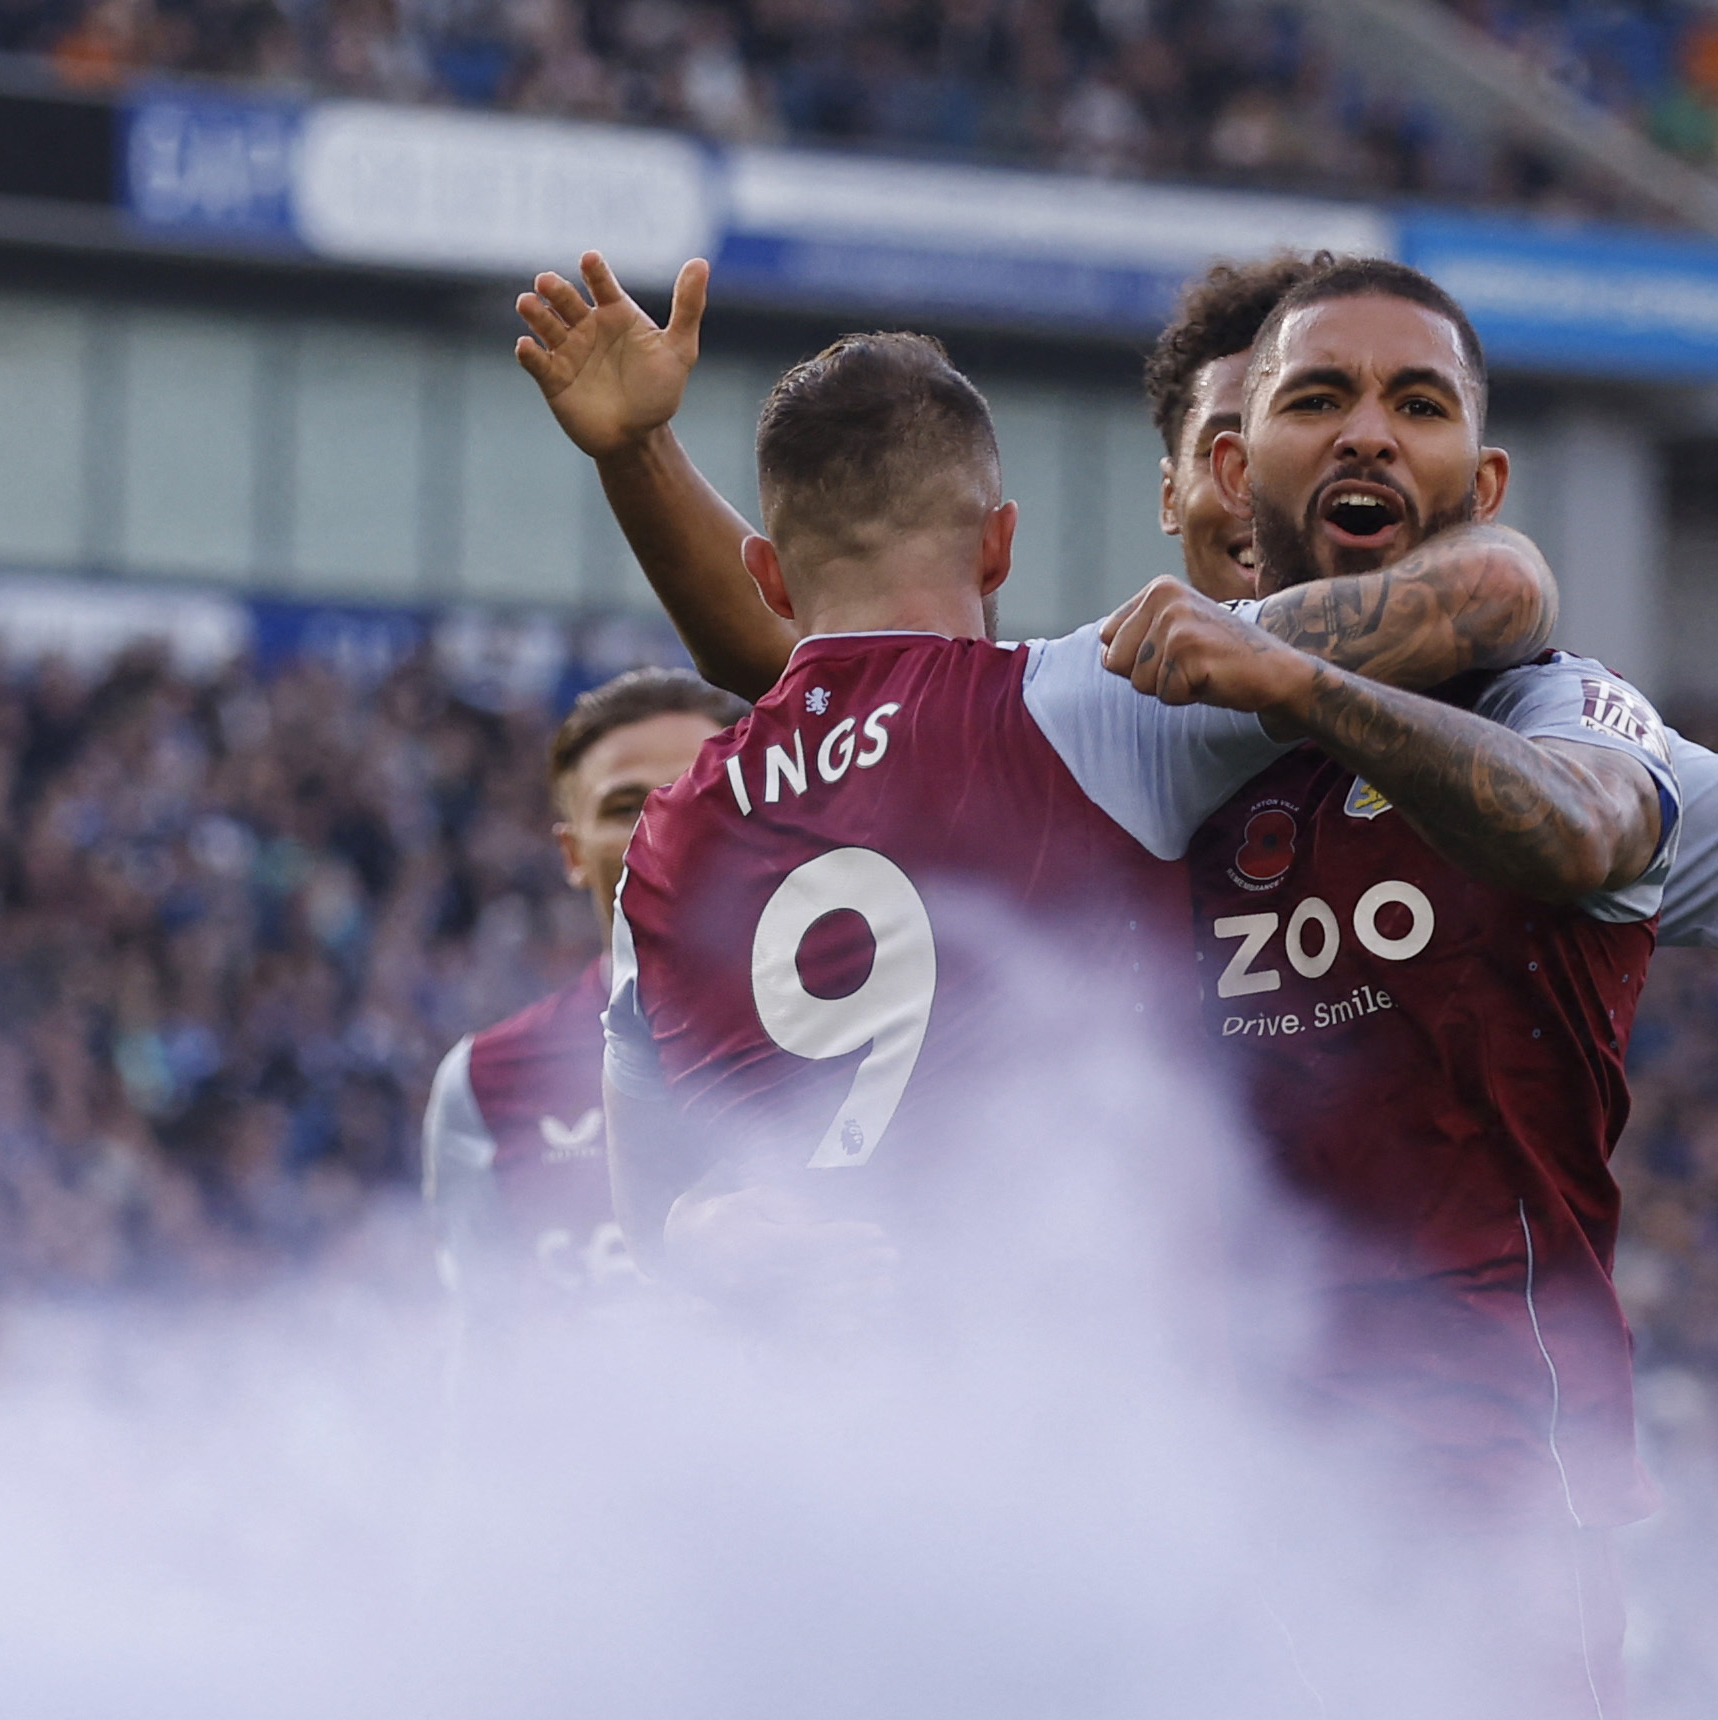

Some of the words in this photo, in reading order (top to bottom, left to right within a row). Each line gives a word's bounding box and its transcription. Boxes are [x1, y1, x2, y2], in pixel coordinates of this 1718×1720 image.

[725, 701, 901, 817] INGS
[1250, 800, 1278, 811] ASTON
[1280, 800, 1299, 812] VILLA
[1226, 868, 1280, 891] REMEMBRANCE
[1196, 880, 1435, 998] ZOO
[751, 846, 937, 1169] 9
[1222, 1012, 1306, 1036] Drive.
[1313, 985, 1398, 1028] Smile.
